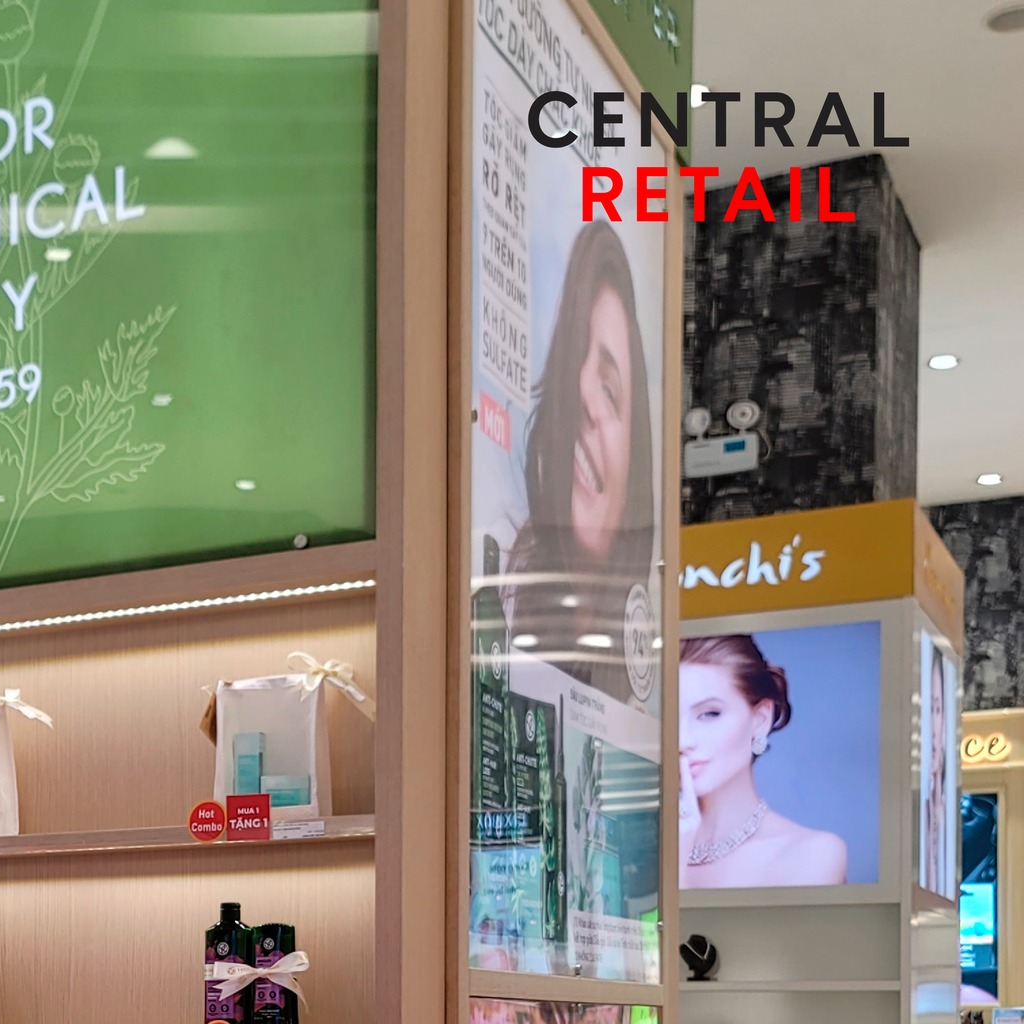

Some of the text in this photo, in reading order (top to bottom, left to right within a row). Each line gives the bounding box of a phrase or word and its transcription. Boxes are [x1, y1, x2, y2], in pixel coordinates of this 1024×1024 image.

[483, 297, 526, 359] KHÔNG
[483, 333, 526, 393] SULFATE
[678, 533, 826, 590] nchi's
[198, 809, 215, 819] Hot
[237, 807, 254, 815] MUA
[192, 822, 223, 832] Combo
[229, 816, 261, 831] TẶNG
[263, 818, 268, 828] 1
